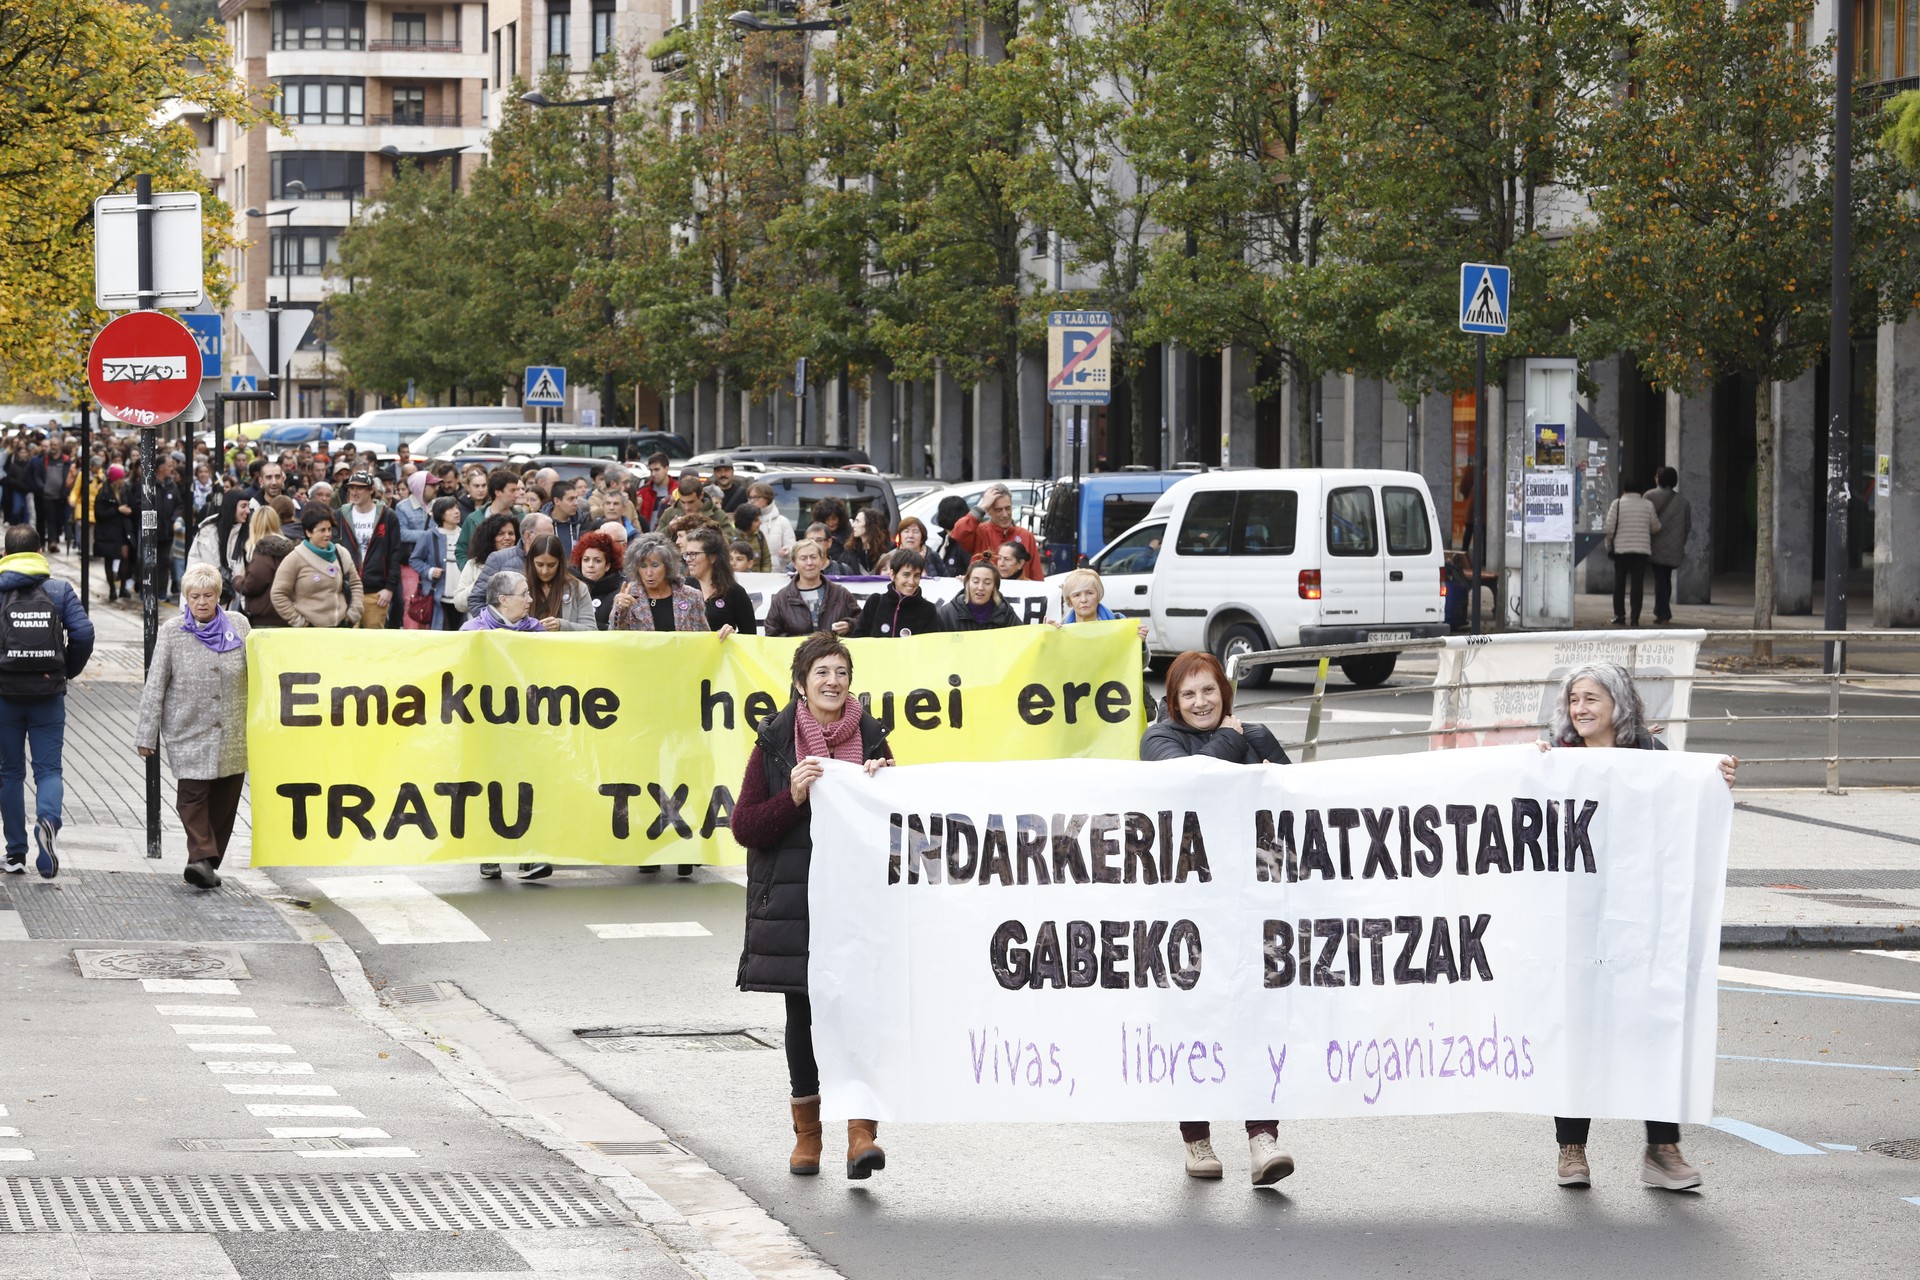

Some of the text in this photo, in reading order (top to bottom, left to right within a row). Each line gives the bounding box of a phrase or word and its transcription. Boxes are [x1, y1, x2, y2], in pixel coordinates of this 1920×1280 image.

[1090, 314, 1108, 324] O.T.A.
[196, 336, 218, 355] XI
[1560, 484, 1569, 497] DA
[10, 611, 51, 619] GOIERRI
[13, 620, 49, 628] GARAIA
[7, 650, 55, 658] ATLETISMO
[279, 671, 1132, 731] Emakume heuei ere
[275, 781, 533, 840] TRATU
[887, 797, 1599, 886] INDARKERIA MATXISTARIK
[989, 913, 1494, 991] GABEKO BIZITZAK
[968, 1014, 1535, 1105] Vivas, libres y organizadas
